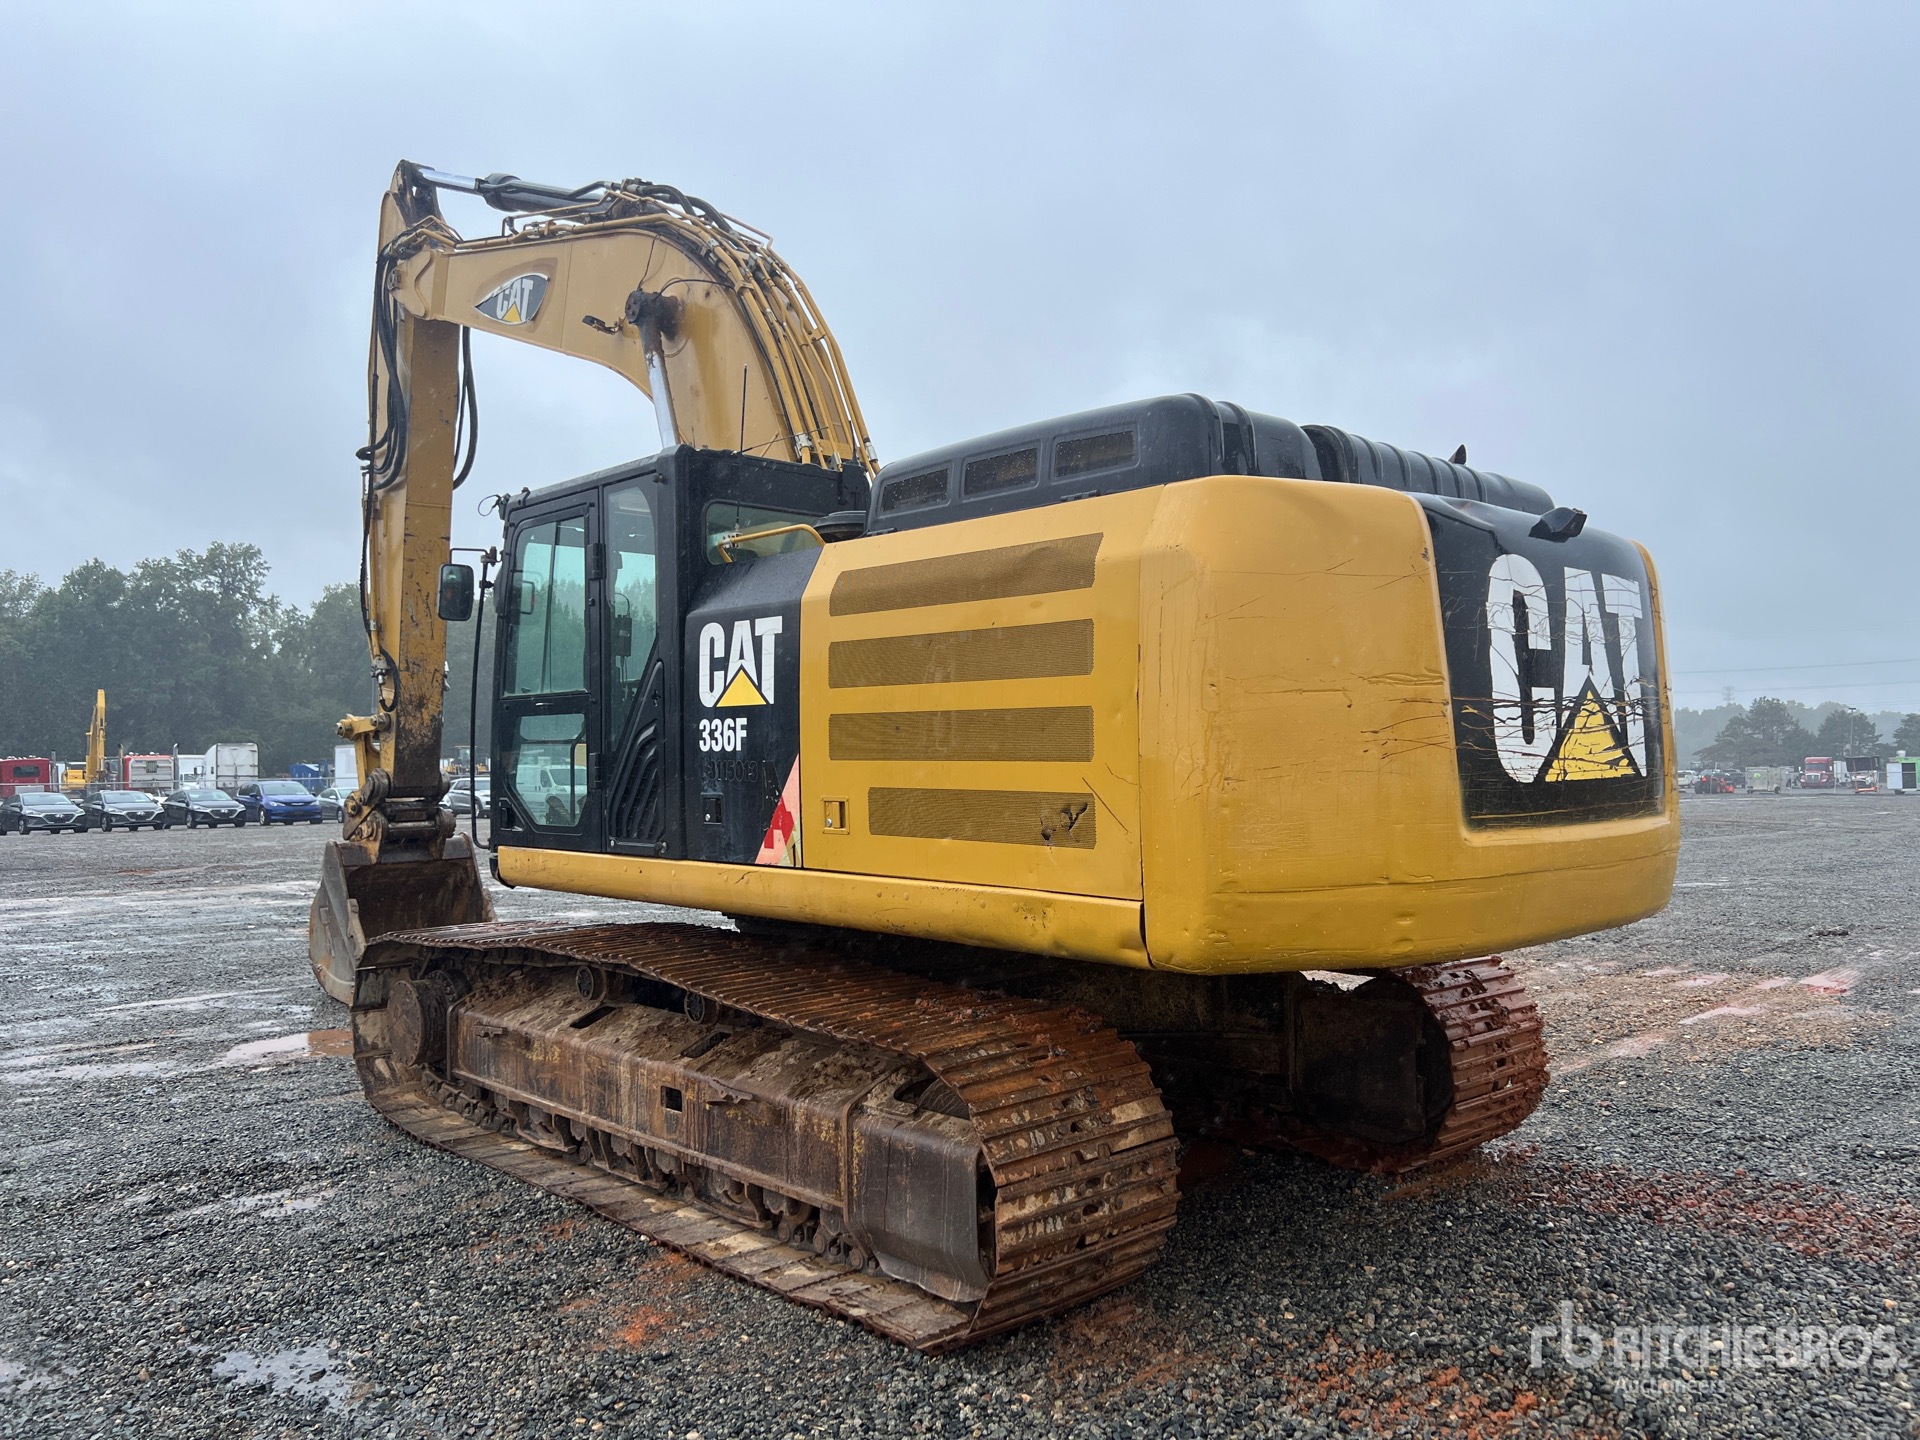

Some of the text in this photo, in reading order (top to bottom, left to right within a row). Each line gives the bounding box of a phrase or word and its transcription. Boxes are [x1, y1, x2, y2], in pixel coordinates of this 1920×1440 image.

[496, 278, 534, 321] CAT
[699, 616, 782, 708] CAT
[1486, 553, 1647, 783] CAT
[699, 717, 747, 751] 336F
